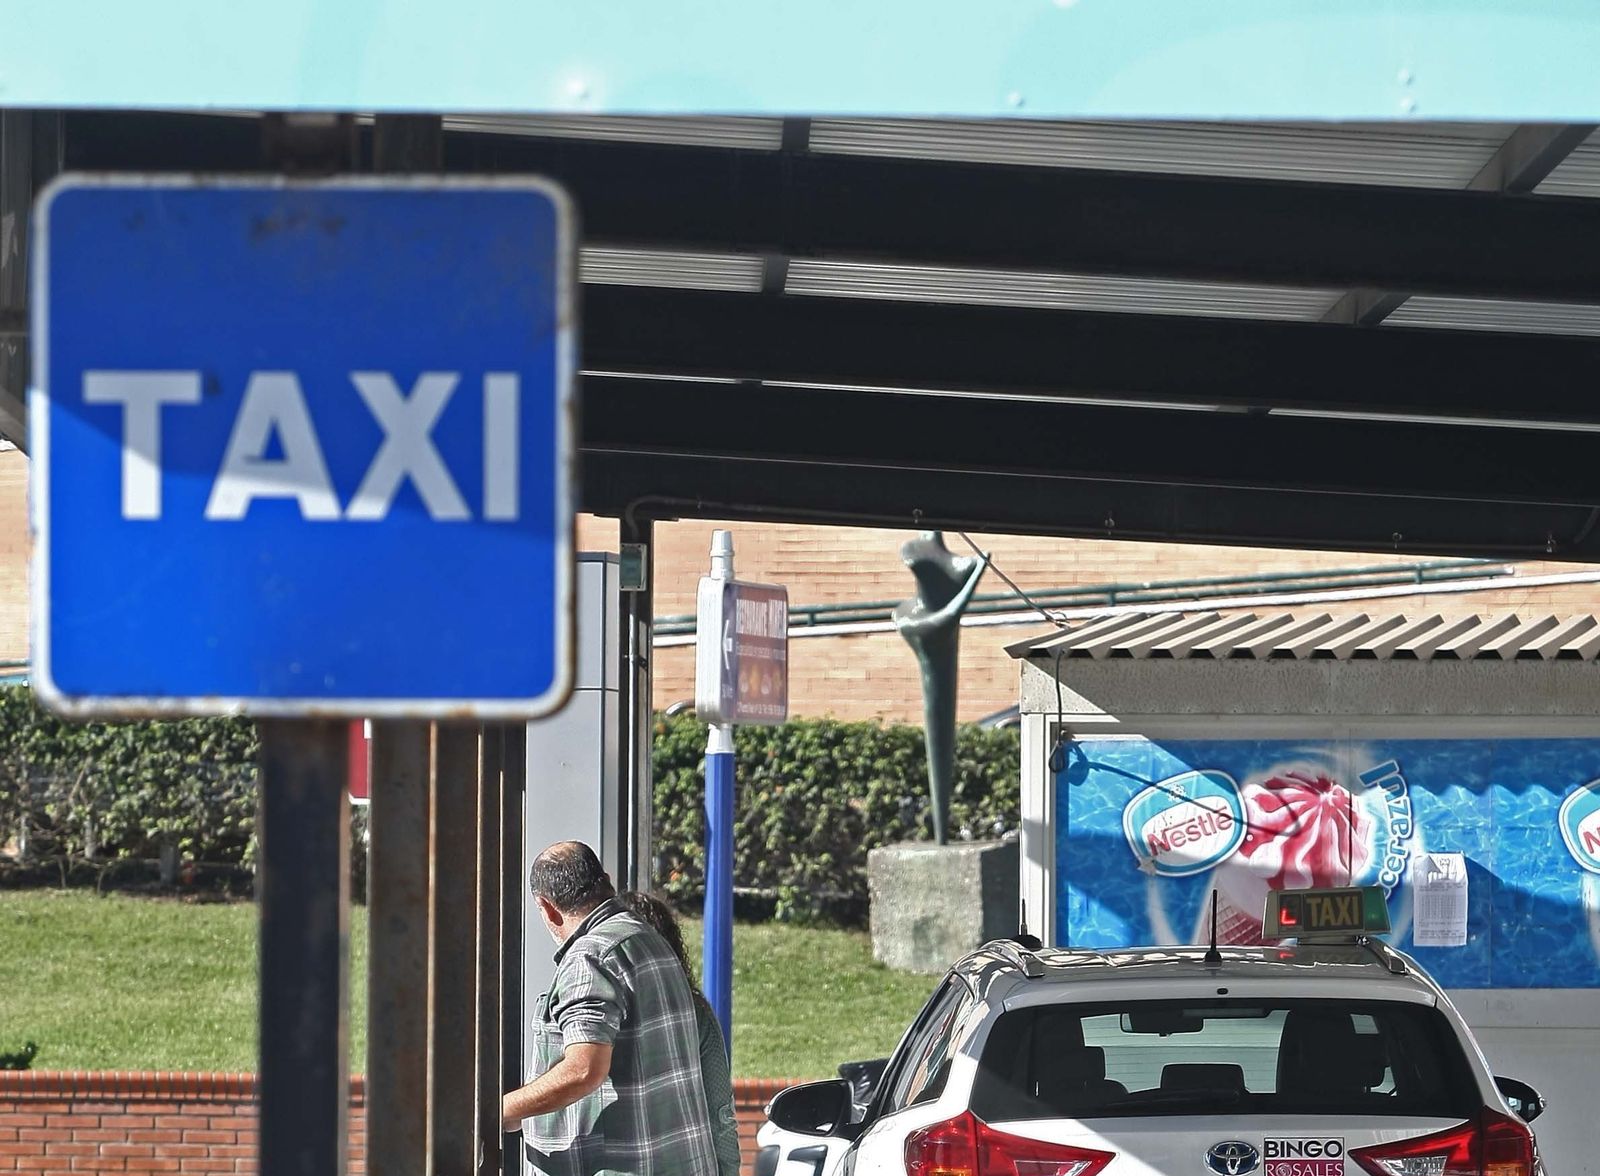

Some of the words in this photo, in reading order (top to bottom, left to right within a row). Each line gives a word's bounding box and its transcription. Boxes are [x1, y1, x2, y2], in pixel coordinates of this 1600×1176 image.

[82, 370, 522, 522] TAXI
[1147, 806, 1233, 857] Nestlé
[1307, 895, 1361, 928] TAXI
[1264, 1140, 1343, 1158] BINGO
